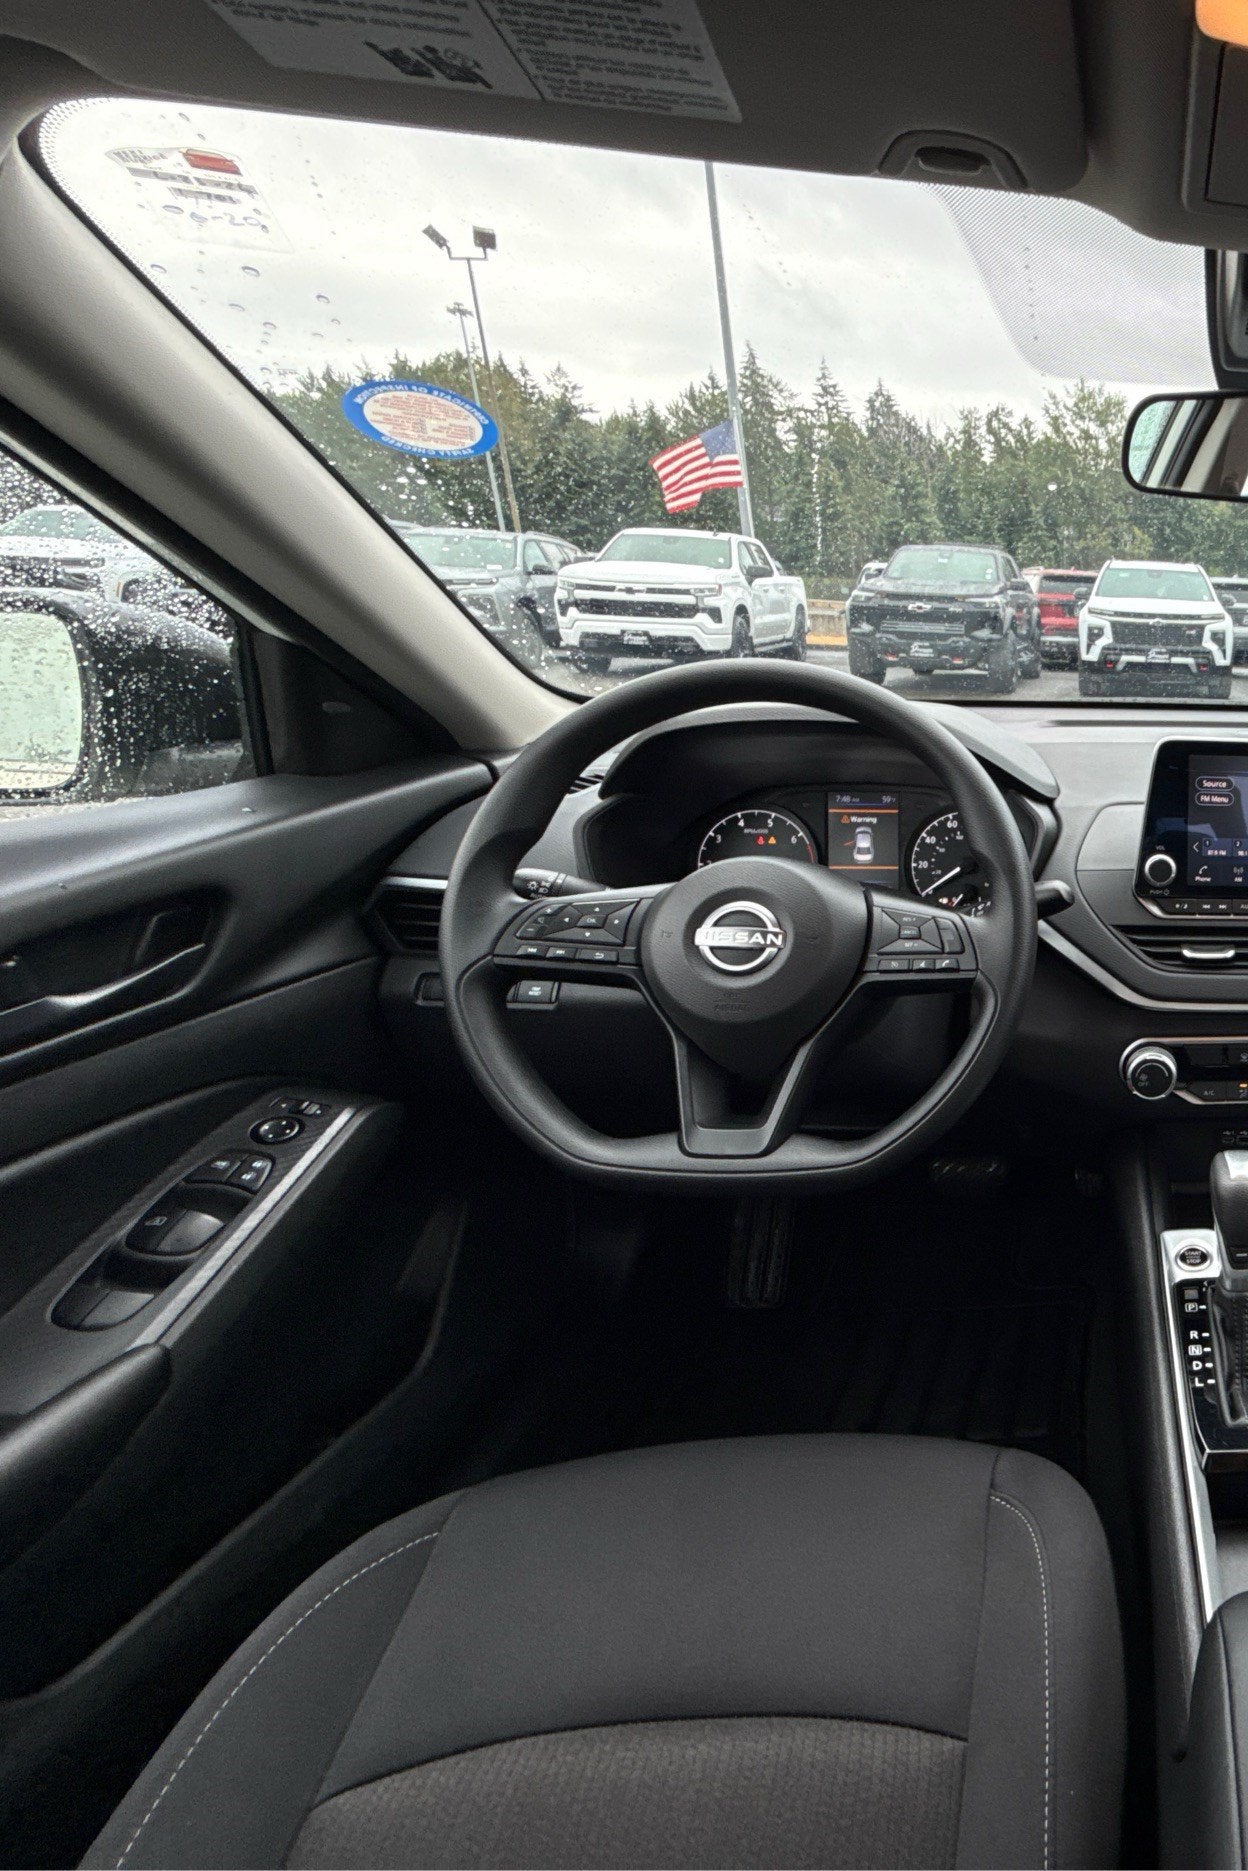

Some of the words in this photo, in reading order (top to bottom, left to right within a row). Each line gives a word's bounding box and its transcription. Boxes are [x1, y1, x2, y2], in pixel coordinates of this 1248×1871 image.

[1202, 780, 1227, 788] Source
[1200, 795, 1211, 803] FM
[1211, 795, 1229, 803] Menu
[738, 819, 745, 828] 4
[767, 819, 774, 828] 5
[850, 815, 878, 824] Warning
[946, 820, 958, 829] 60
[715, 834, 722, 844] 3
[790, 835, 798, 844] 6
[925, 835, 937, 844] 40
[917, 860, 929, 869] 20
[702, 930, 783, 946] NISSAN
[1189, 1330, 1199, 1340] R
[1192, 1360, 1203, 1371] D
[1194, 1376, 1205, 1387] L
